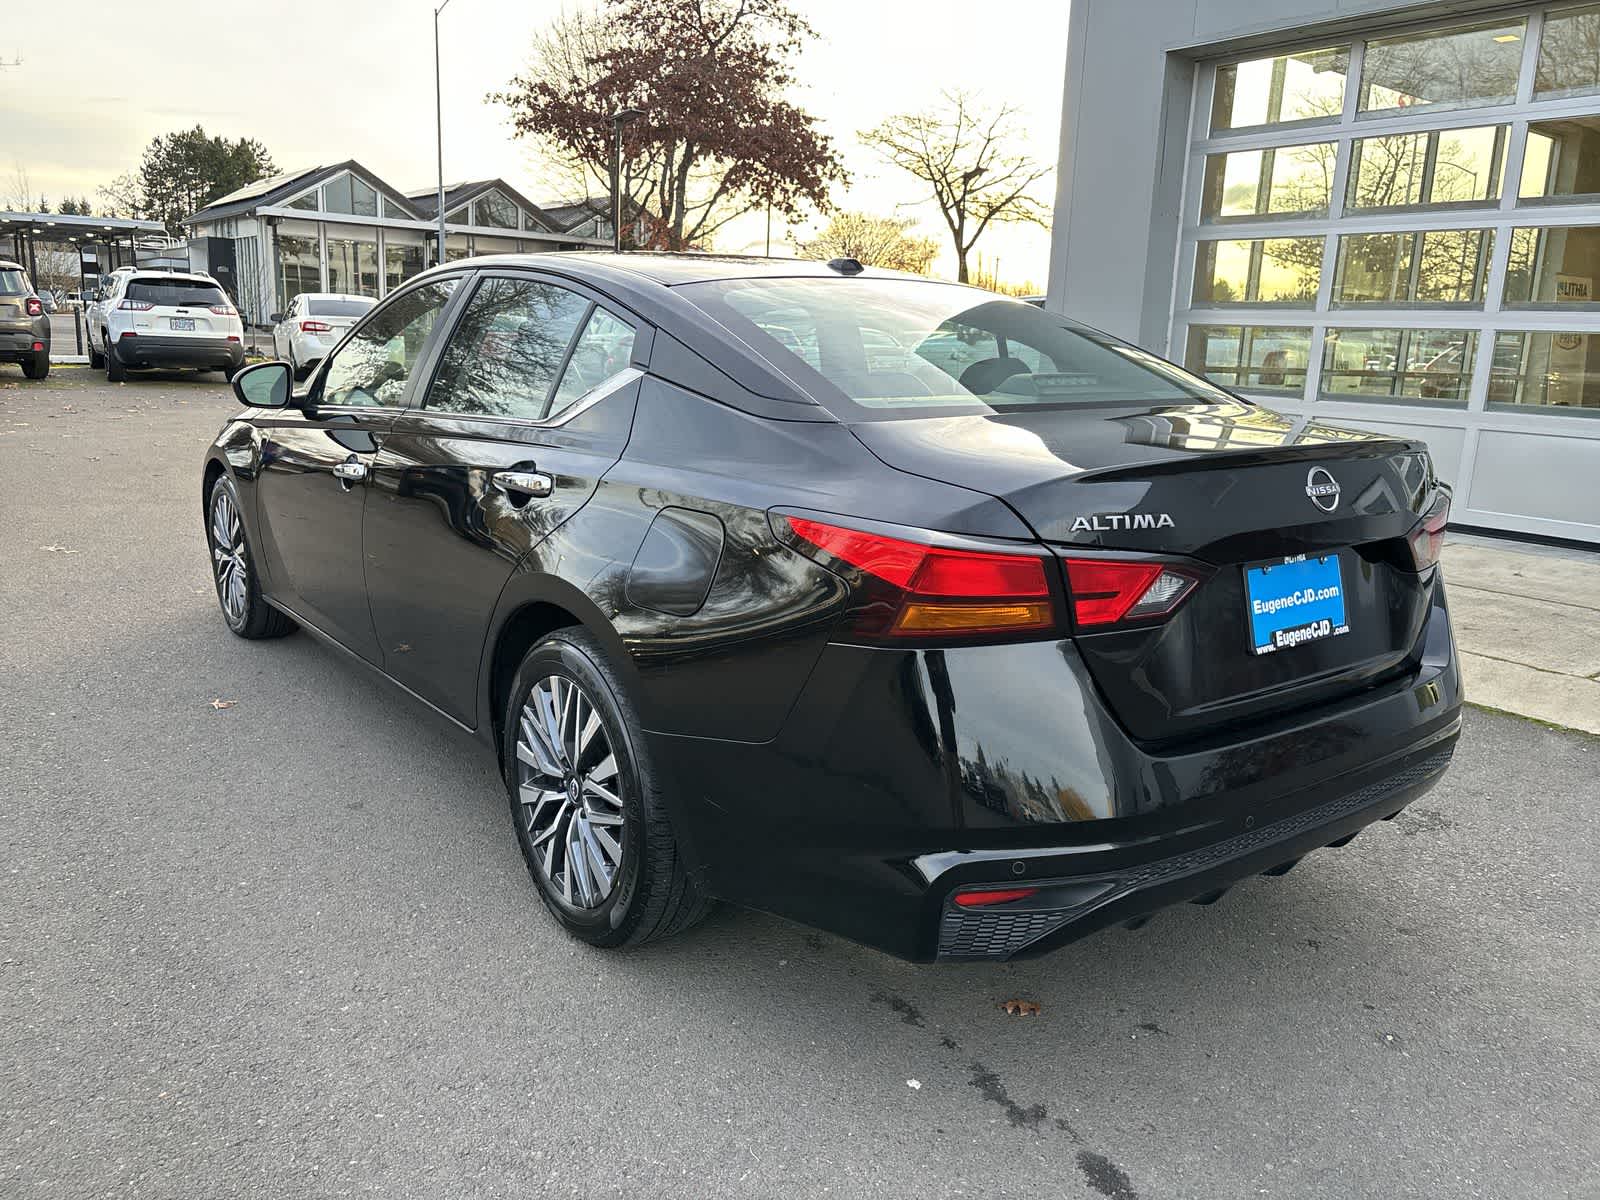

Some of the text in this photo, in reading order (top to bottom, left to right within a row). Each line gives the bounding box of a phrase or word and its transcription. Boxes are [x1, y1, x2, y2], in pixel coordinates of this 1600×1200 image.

[1564, 282, 1587, 297] LITHIA
[1306, 485, 1339, 497] NISSA
[1070, 513, 1176, 532] ALTIMA
[1253, 586, 1339, 614] EugeneCJD.com
[1275, 620, 1331, 647] EugeneCJD
